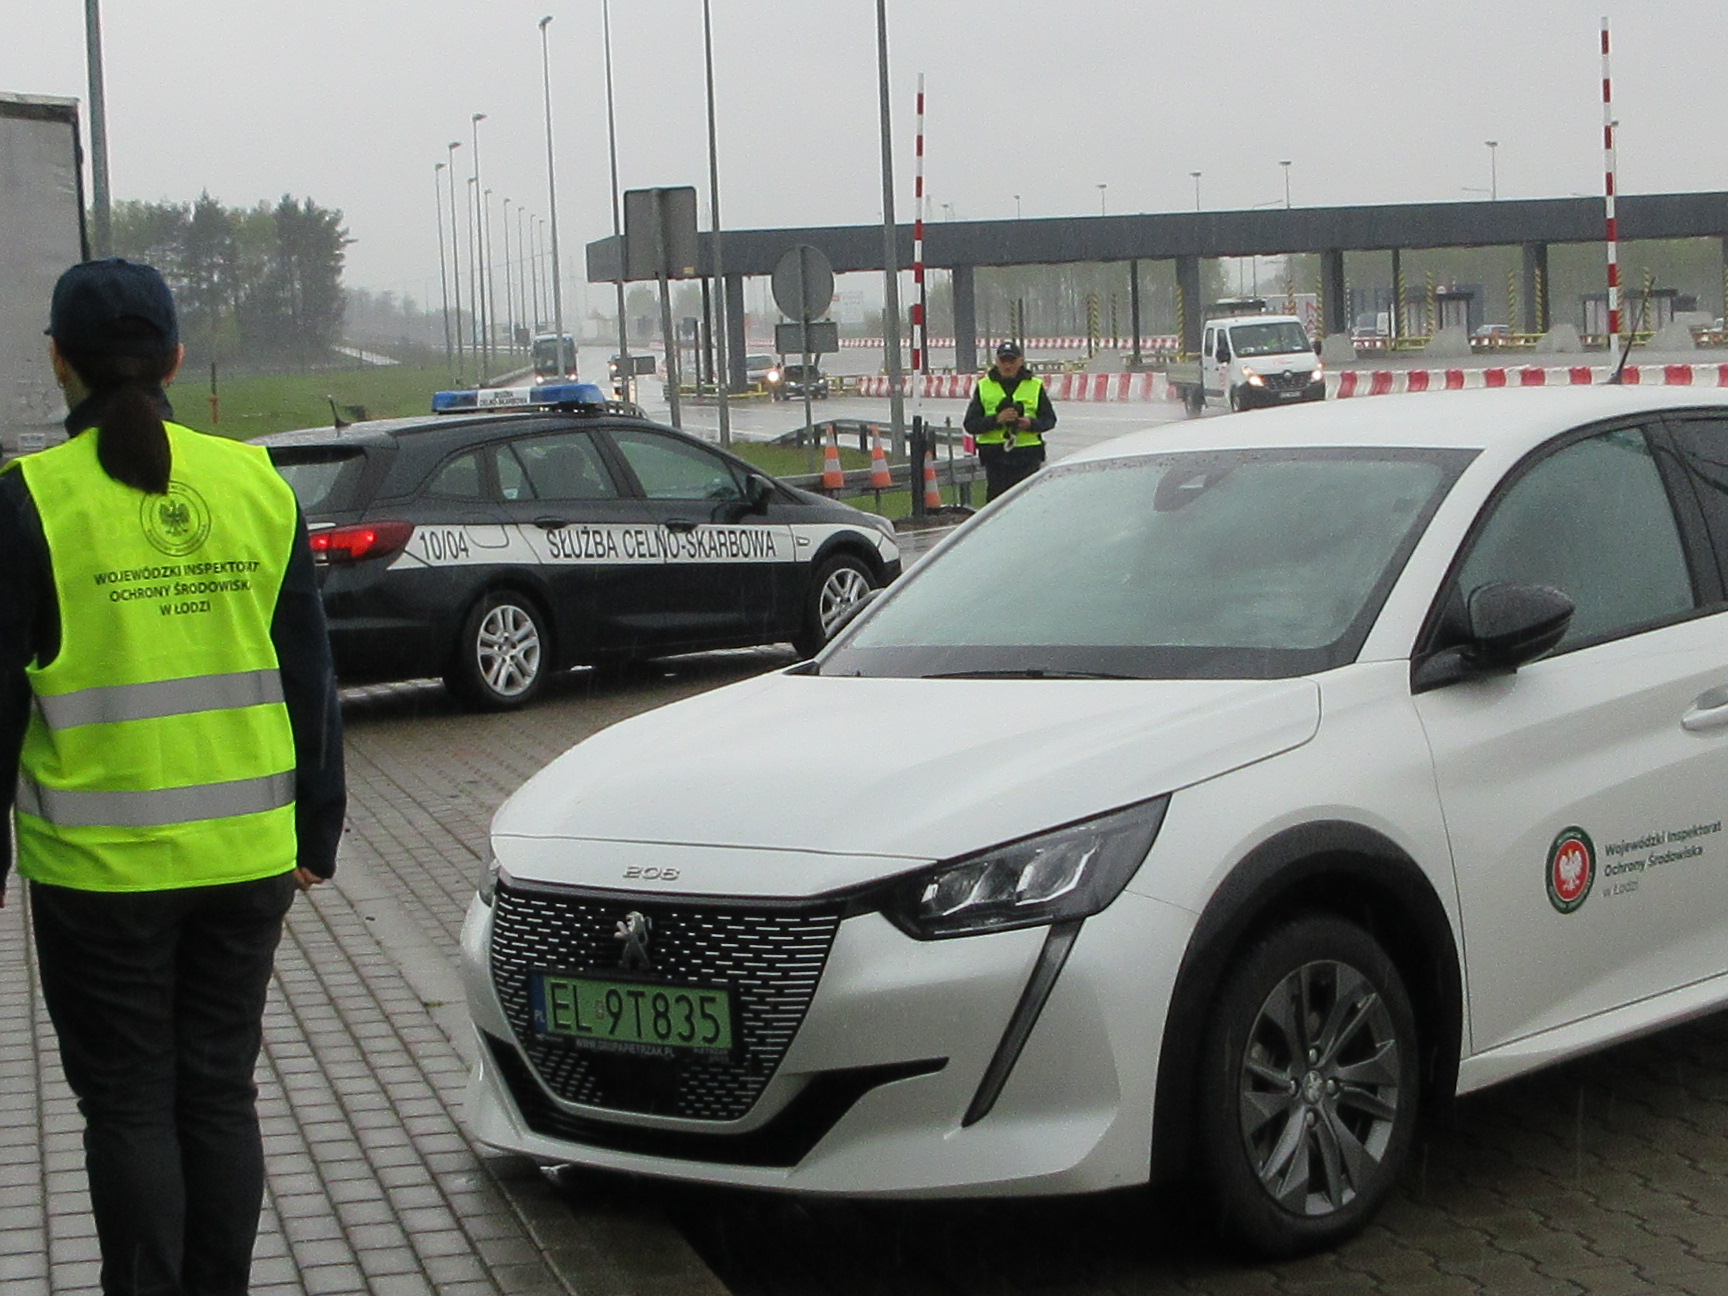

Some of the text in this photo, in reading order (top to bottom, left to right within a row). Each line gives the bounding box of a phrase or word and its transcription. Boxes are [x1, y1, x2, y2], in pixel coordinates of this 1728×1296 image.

[419, 529, 470, 561] 10/04
[545, 525, 777, 560] SŁUŻBA CELNO-SKARBOWA
[94, 561, 260, 585] WOJEWÓDZKI INSPEKTOAT
[109, 579, 252, 602] OCHRONY ŚRODOWISK
[160, 600, 211, 616] W ŁODZI
[622, 865, 681, 881] 208
[1603, 856, 1647, 877] Ochrony
[534, 1009, 546, 1023] PL
